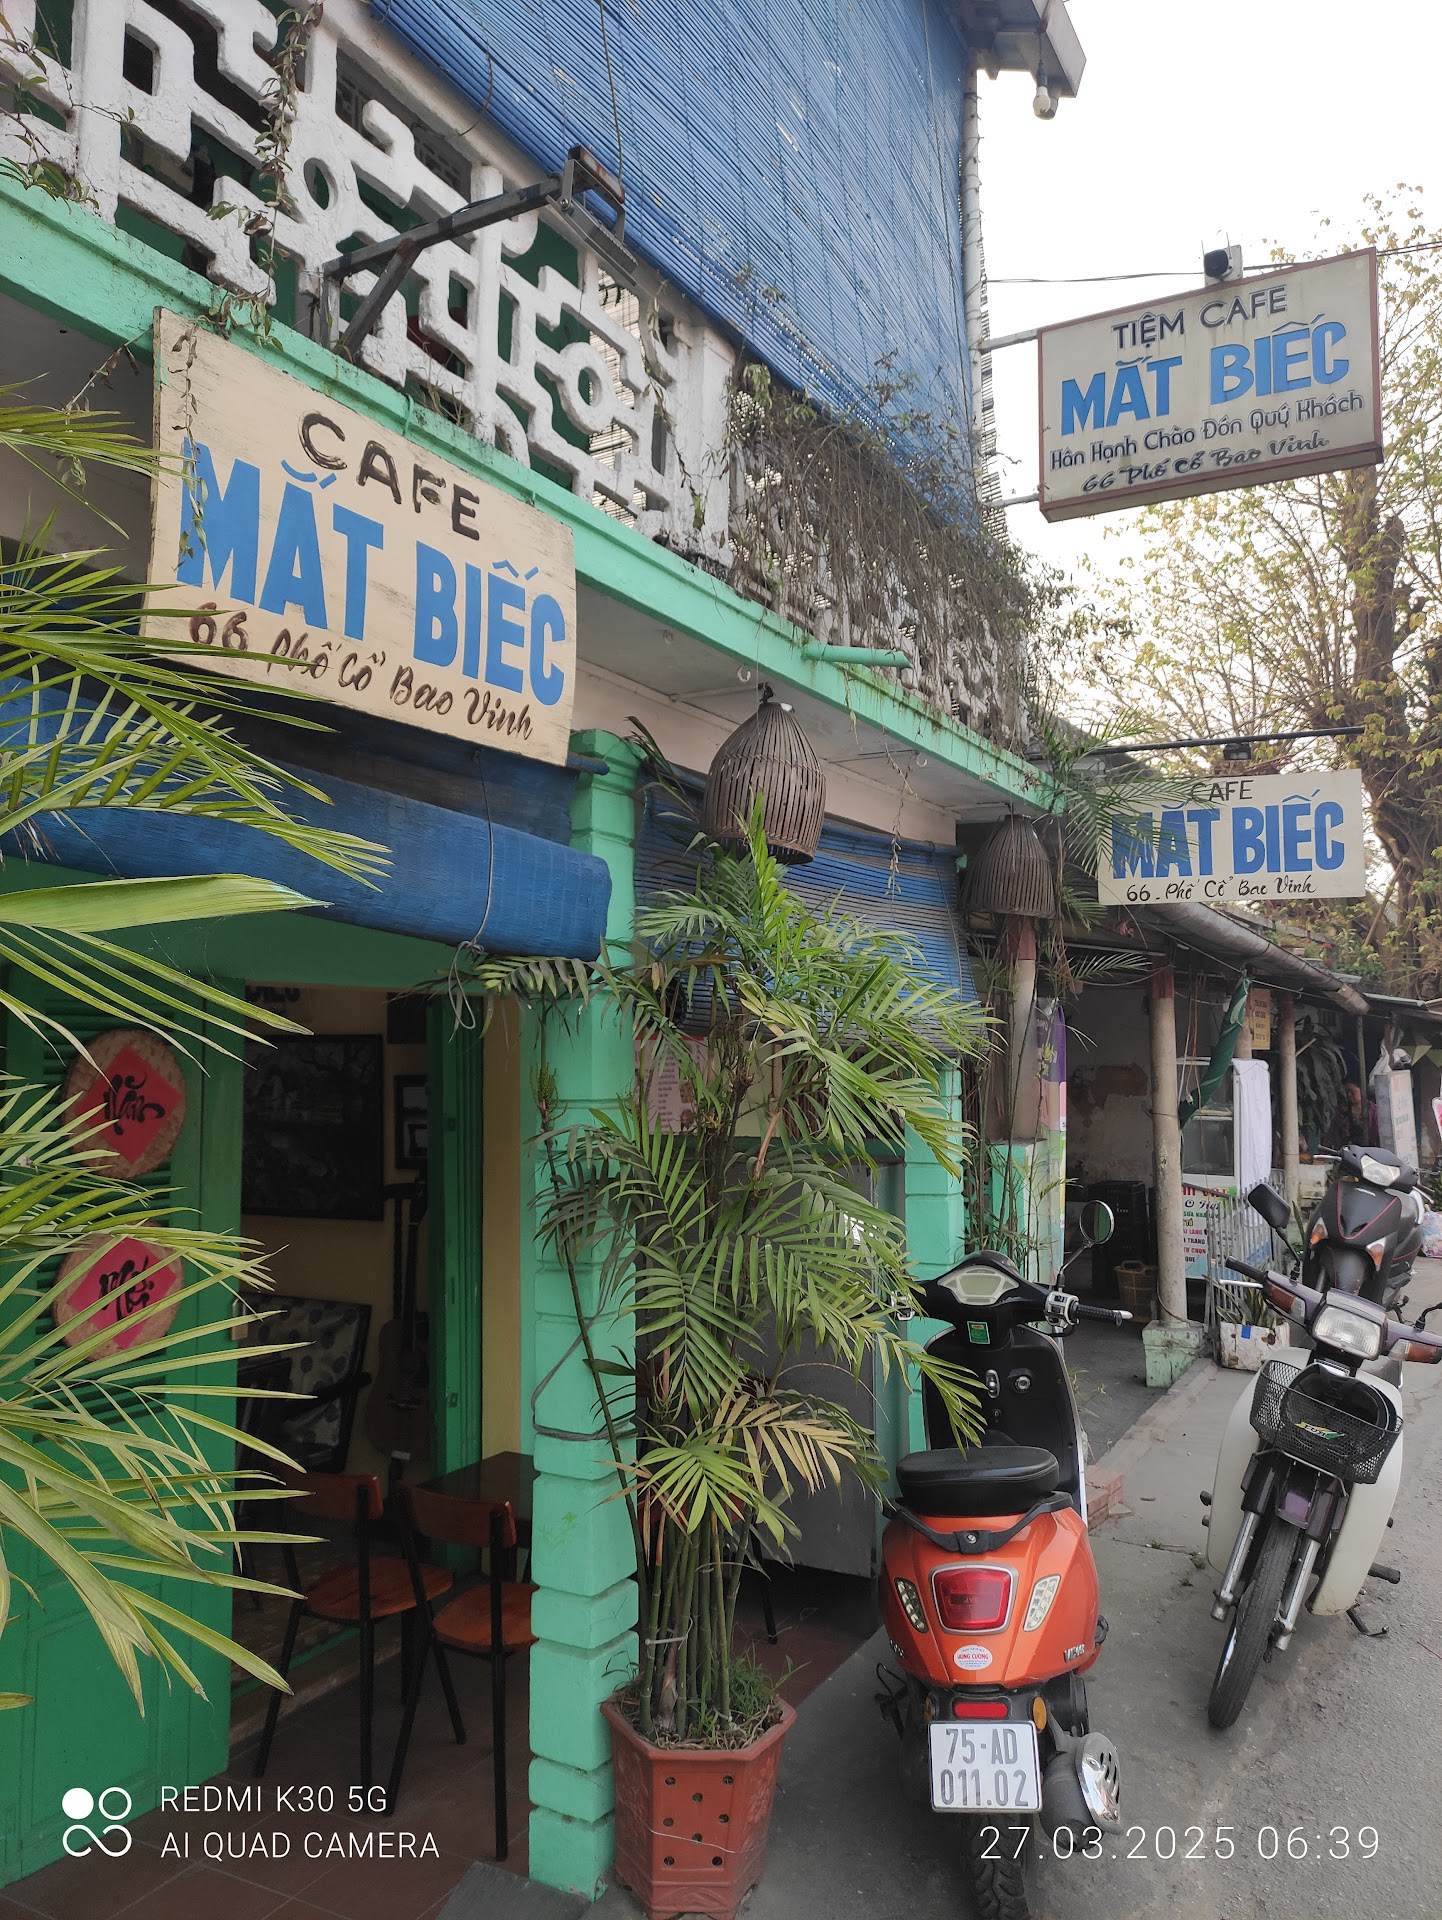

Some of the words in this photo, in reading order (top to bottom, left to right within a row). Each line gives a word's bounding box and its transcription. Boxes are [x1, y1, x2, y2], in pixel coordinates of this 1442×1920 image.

[1112, 309, 1185, 349] TIỆM
[1199, 284, 1288, 328] CAFE
[1061, 356, 1183, 436] MẮT
[1210, 314, 1350, 405] BIẾC
[1050, 446, 1086, 471] Hân
[1090, 435, 1138, 464] Hạnh
[1143, 425, 1197, 451] Chào
[1201, 415, 1243, 440] Đón
[1248, 403, 1291, 435] Quý
[1296, 389, 1364, 422] Khách
[1081, 471, 1116, 492] 66
[1117, 458, 1171, 485] Phố
[1173, 451, 1205, 474] Cổ
[1209, 447, 1261, 467] Bao
[1267, 430, 1329, 456] Vinh
[299, 411, 481, 541] CAFE
[176, 436, 384, 642] MẮT
[413, 541, 566, 706] BIẾC
[188, 602, 249, 651] 66
[267, 628, 342, 679] Phố
[338, 651, 387, 691] Cổ
[389, 665, 454, 715] Bao
[463, 687, 534, 741] Vinh
[1190, 780, 1254, 801] CAFE
[1111, 800, 1221, 880] MẮT
[1232, 789, 1345, 875] BIẾC
[1126, 884, 1151, 902] 66
[1165, 879, 1201, 900] Phố
[1203, 876, 1234, 898] Cổ
[1274, 874, 1318, 895] Vinh
[946, 1729, 1018, 1764] 75-AD
[941, 1769, 1028, 1806] 011.02
